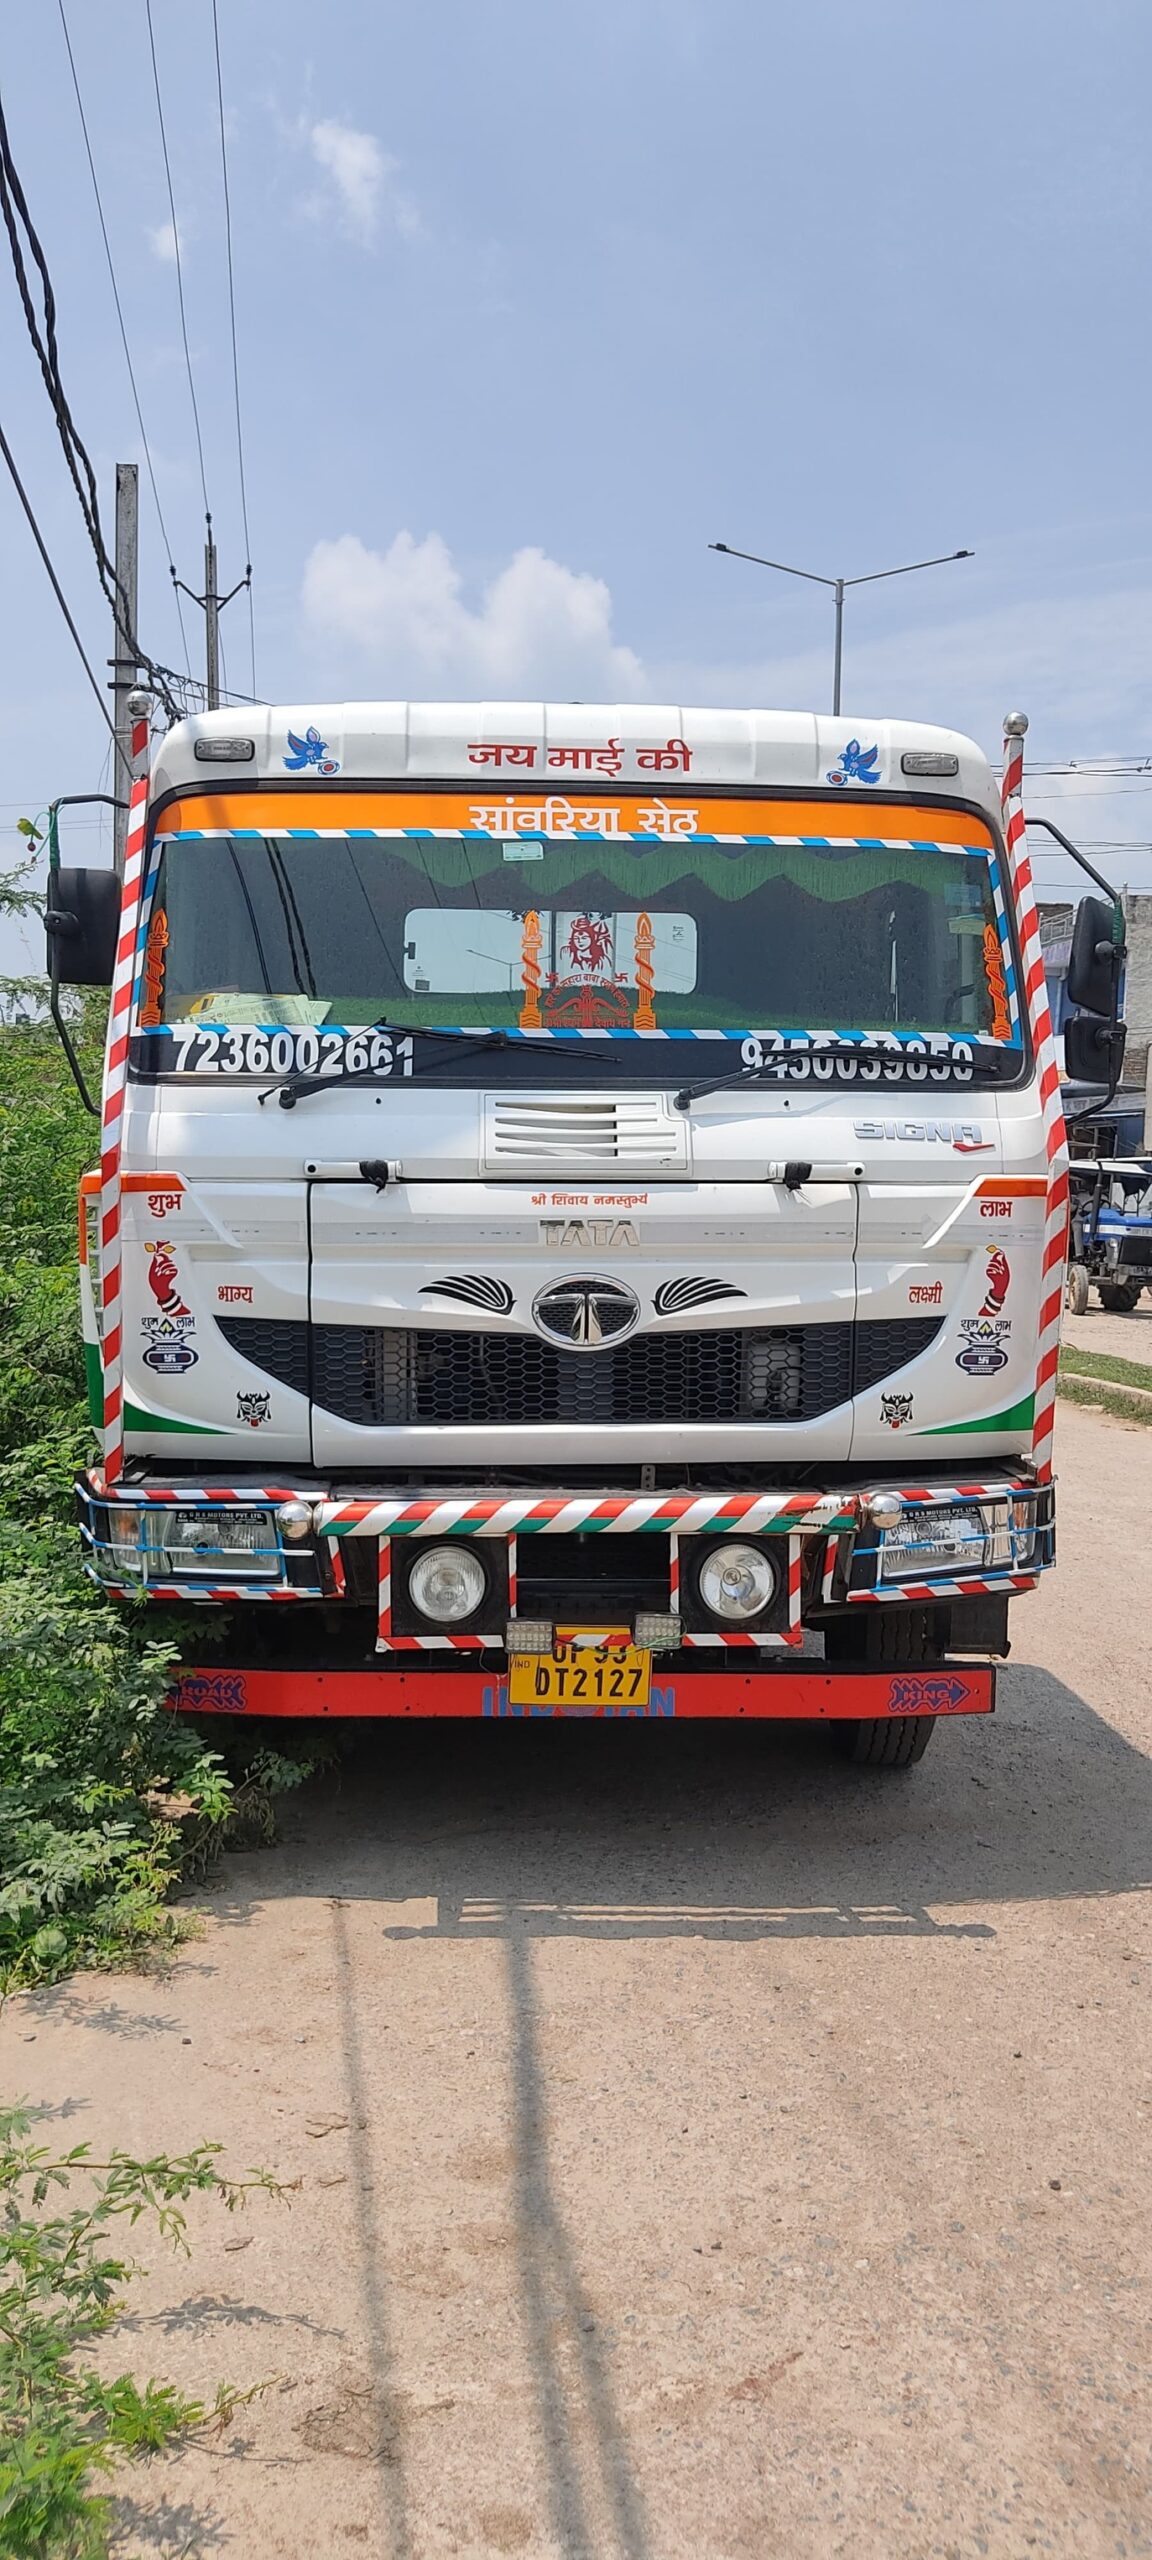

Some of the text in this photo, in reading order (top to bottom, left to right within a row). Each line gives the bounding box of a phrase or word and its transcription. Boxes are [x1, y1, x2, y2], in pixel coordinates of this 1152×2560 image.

[467, 738, 693, 777] जय माई की
[469, 797, 699, 832] सांवरिया सेठ
[172, 1031, 414, 1077] 7236002661
[853, 1120, 982, 1144] SIGNA
[148, 1194, 183, 1218] शुभ
[531, 1193, 547, 1206] श्री
[552, 1193, 588, 1206] शिवाय
[980, 1201, 1013, 1217] लाभ
[540, 1219, 640, 1246] TATA
[217, 1286, 254, 1304] भाग्य
[909, 1281, 943, 1304] लक्ष्मी
[181, 1686, 233, 1697] ROAD
[535, 1668, 643, 1697] DT2127
[904, 1689, 950, 1700] KING
